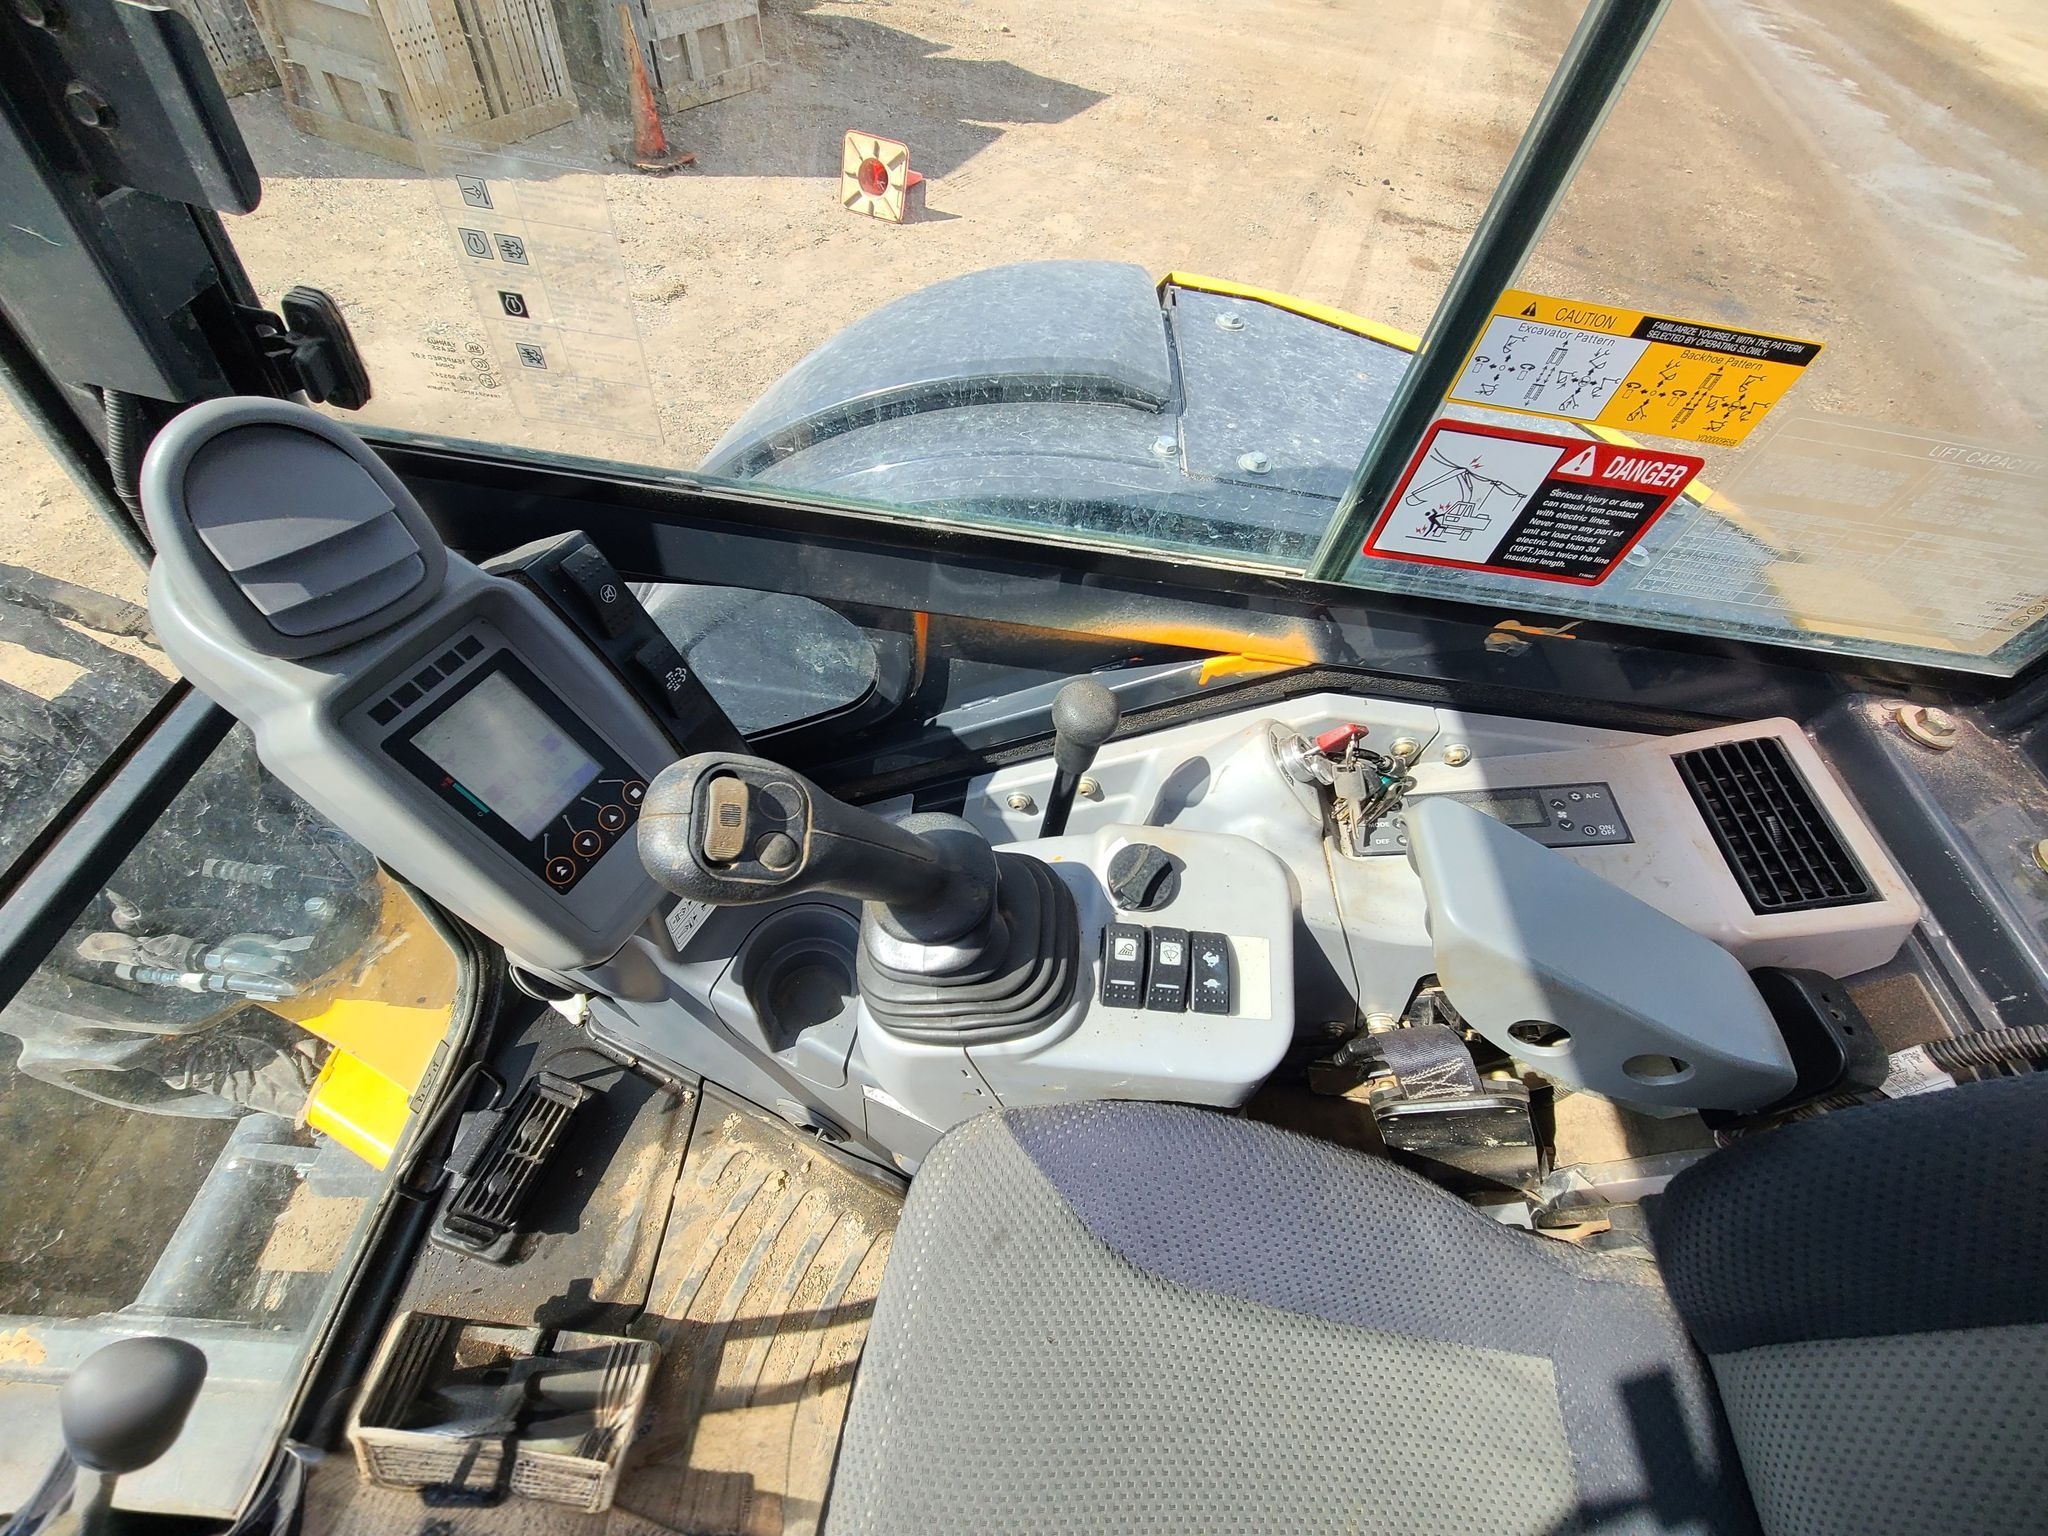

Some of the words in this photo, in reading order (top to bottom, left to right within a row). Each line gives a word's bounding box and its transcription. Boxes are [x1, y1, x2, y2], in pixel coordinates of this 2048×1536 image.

[1555, 307, 1617, 329] CAUTION
[1518, 322, 1573, 339] Excavator
[1574, 331, 1616, 347] Pattern
[1646, 330, 1685, 343] SELECTED
[1683, 336, 1697, 345] BY
[1695, 337, 1739, 352] OPERATING
[1737, 344, 1769, 357] SLOWLY.
[1652, 321, 1699, 336] FAMILIARIZE
[1697, 328, 1738, 342] YOURSELF
[1735, 335, 1756, 346] WITH
[1755, 338, 1772, 348] THE
[1769, 341, 1805, 353] PATTERN
[1680, 349, 1724, 364] Backhoe
[1724, 357, 1763, 371] Pattern
[1928, 445, 1967, 460] LIFT
[1602, 455, 1688, 488] DANGER
[1549, 488, 1583, 501] Serious
[1583, 494, 1609, 506] injury
[1619, 500, 1645, 509] death
[1535, 509, 1555, 517] with
[1555, 512, 1588, 522] electric
[1588, 516, 1610, 526] lines.
[1542, 500, 1559, 508] can
[1559, 502, 1586, 512] result
[1584, 505, 1606, 515] from
[1605, 509, 1639, 519] contact
[1528, 517, 1554, 527] Never
[1554, 523, 1578, 531] move
[1578, 525, 1596, 534] any
[1593, 528, 1614, 536] part
[1515, 536, 1548, 546] electric
[1548, 540, 1565, 549] line
[1565, 542, 1585, 552] than
[1585, 545, 1600, 553] 3M
[1551, 531, 1571, 540] load
[1570, 535, 1597, 544] closer
[1503, 553, 1540, 563] insulator
[1538, 557, 1566, 568] length.
[1555, 551, 1579, 560] twice
[1578, 554, 1593, 562] the
[1593, 556, 1610, 565] line
[1585, 792, 1601, 800] A/C
[1368, 821, 1390, 829] MODE
